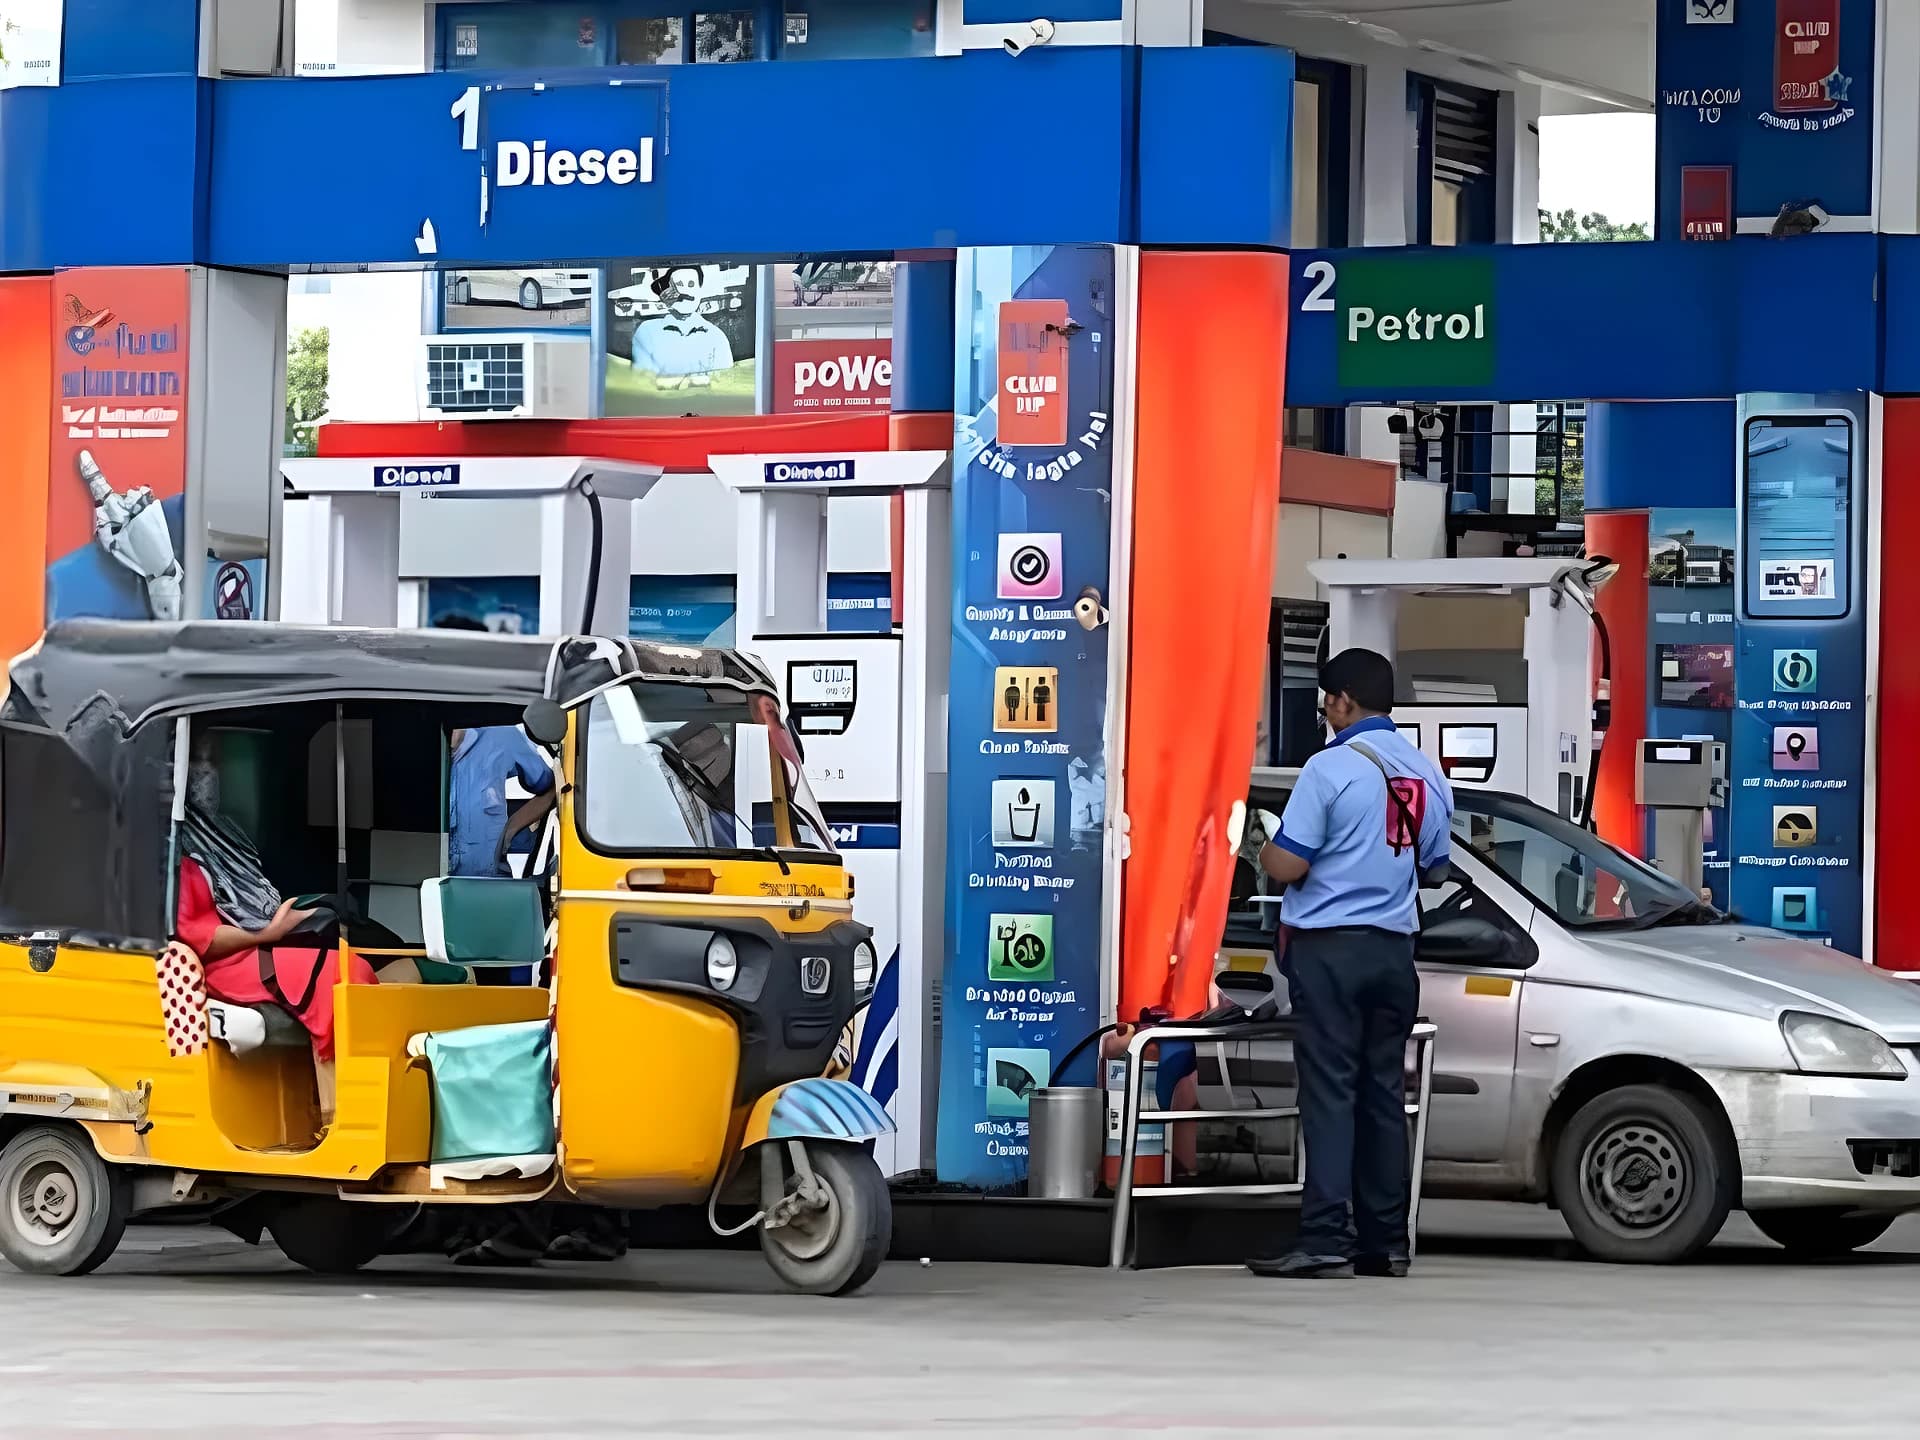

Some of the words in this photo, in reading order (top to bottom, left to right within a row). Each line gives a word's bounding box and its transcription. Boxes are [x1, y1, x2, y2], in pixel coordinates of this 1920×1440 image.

[451, 86, 480, 150] 1
[497, 136, 653, 186] Diesel
[1301, 261, 1336, 311] 2
[1348, 304, 1484, 342] Petrol
